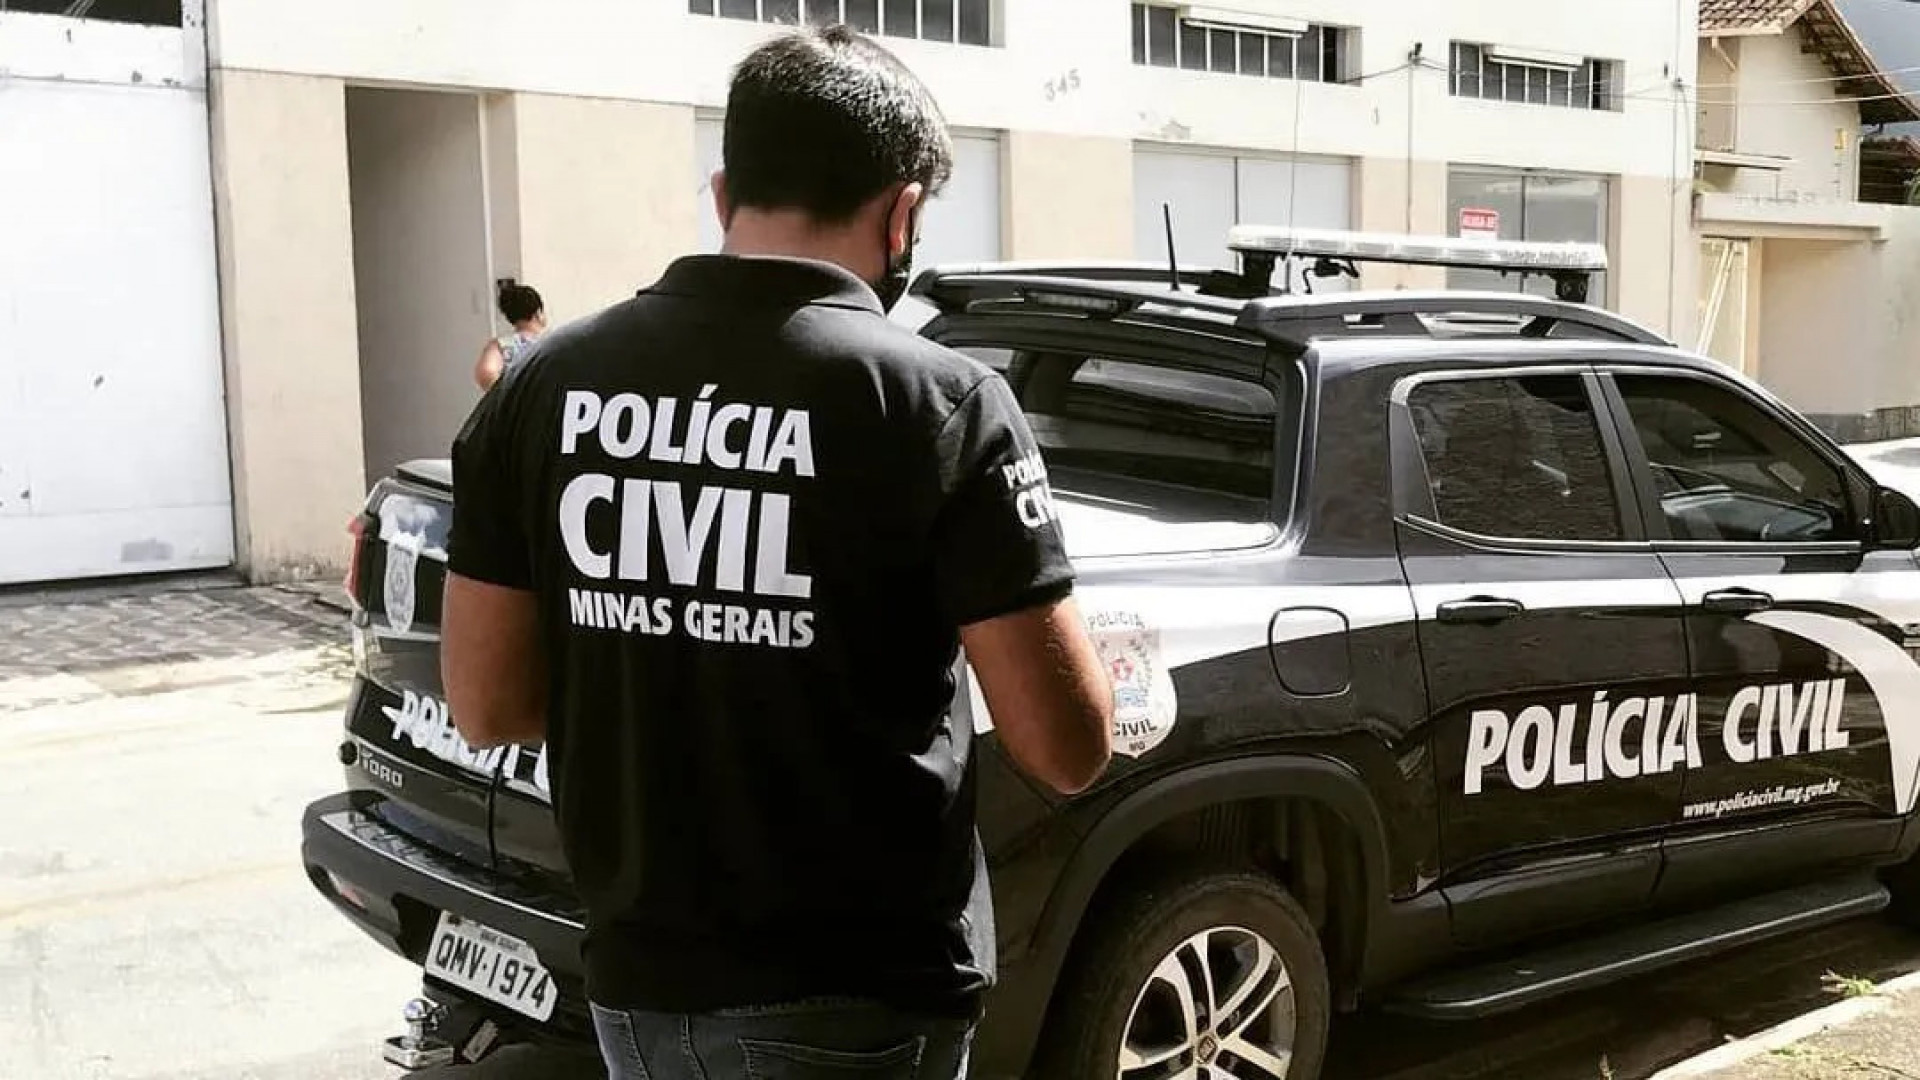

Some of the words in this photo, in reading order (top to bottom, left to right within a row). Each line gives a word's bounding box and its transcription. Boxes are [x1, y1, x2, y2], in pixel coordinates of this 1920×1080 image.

[560, 384, 815, 477] POLÍCIA
[558, 473, 812, 598] CIVIL
[568, 588, 673, 635] MINAS
[684, 603, 815, 648] GERAIS
[361, 752, 403, 788] TORO
[1464, 690, 1703, 795] POLÍCIA
[1722, 678, 1850, 763] CIVIL
